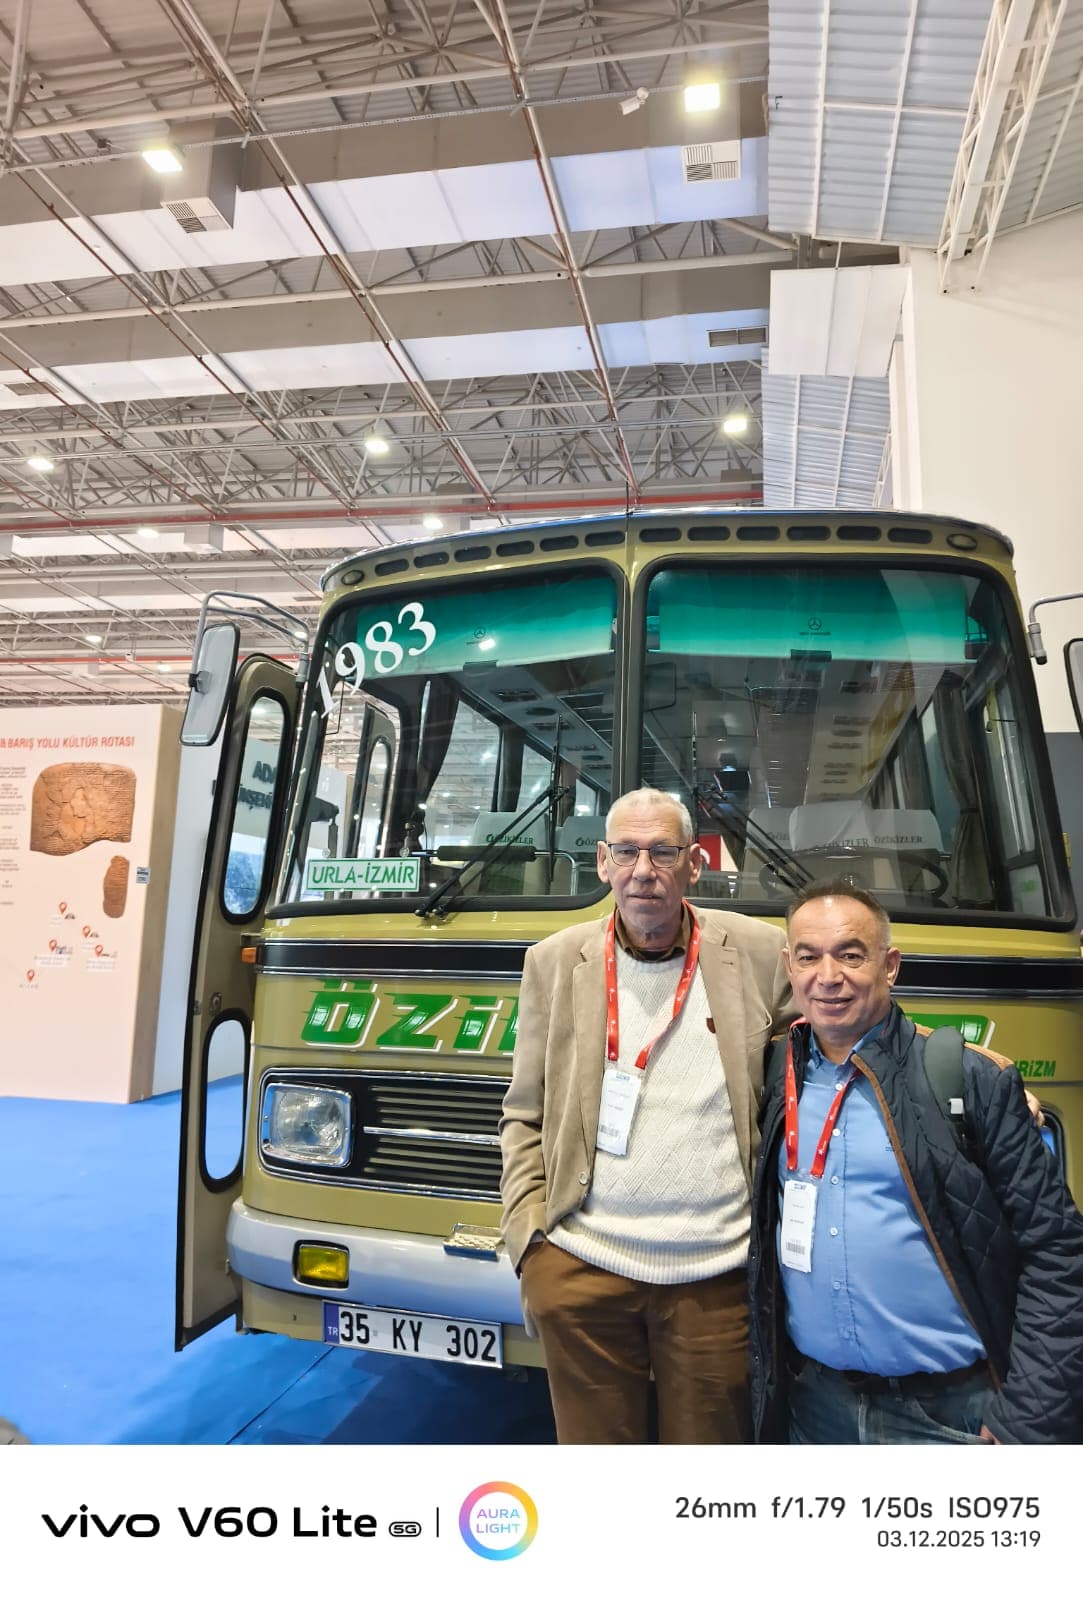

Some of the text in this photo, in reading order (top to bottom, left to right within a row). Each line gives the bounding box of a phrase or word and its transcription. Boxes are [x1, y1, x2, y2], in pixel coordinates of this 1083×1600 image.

[316, 602, 437, 719] 1983
[8, 737, 34, 751] BARIŞ
[37, 737, 60, 748] YOLU
[62, 734, 98, 748] KÜLTÜR
[100, 736, 135, 747] ROTASI
[312, 862, 416, 885] URLA-İZMİR
[1015, 1059, 1057, 1078] RİZM
[327, 1326, 338, 1337] TR
[340, 1311, 497, 1363] 35 KY 302
